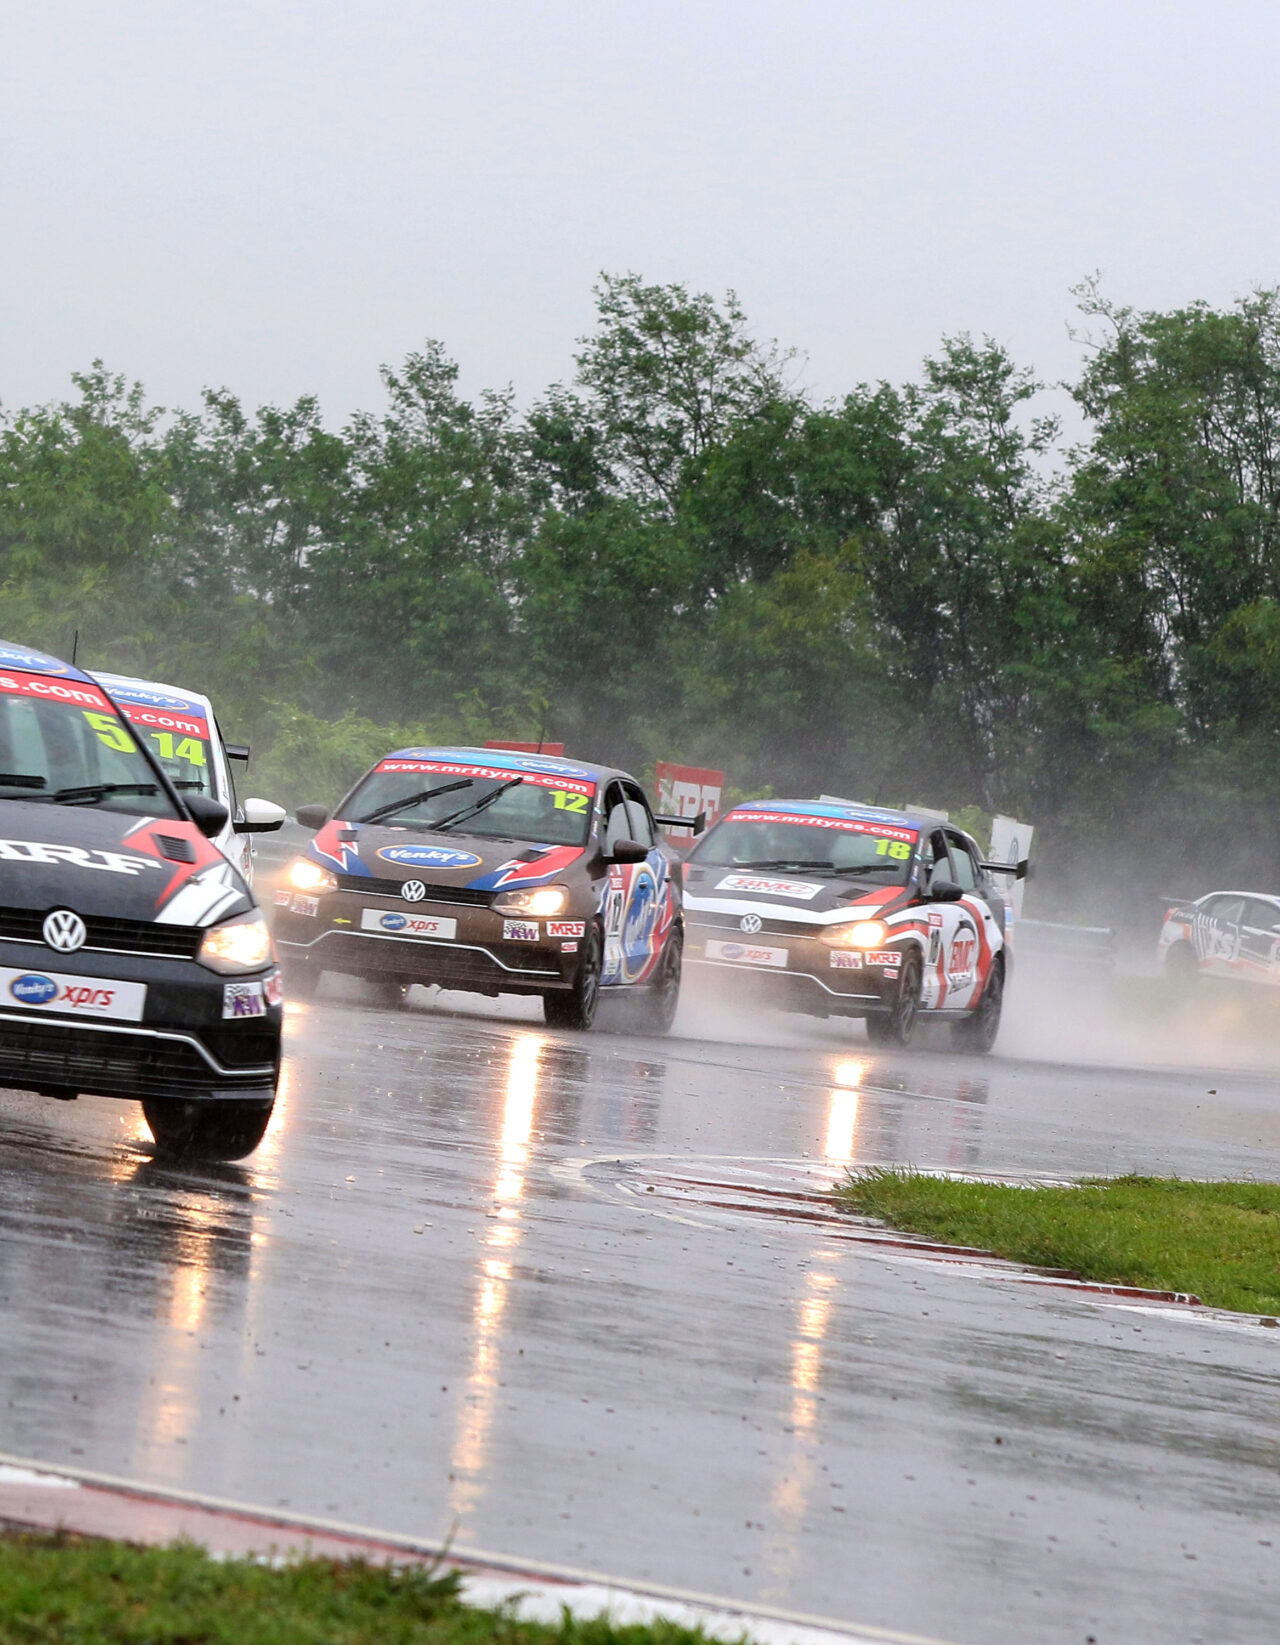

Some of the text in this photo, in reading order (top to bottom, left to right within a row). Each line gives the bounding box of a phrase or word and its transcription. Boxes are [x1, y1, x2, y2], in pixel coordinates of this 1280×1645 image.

[81, 710, 138, 754] 5
[151, 732, 207, 767] 14
[383, 763, 588, 793] www.mrftyres.com
[549, 790, 589, 815] 12
[731, 813, 911, 840] www.mrftyres.com
[389, 848, 470, 861] Venky's
[874, 838, 912, 861] 18
[43, 910, 87, 953] VW
[407, 918, 439, 932] xprs
[550, 923, 585, 936] MRF
[868, 952, 900, 964] MRF
[60, 985, 116, 1008] xprs
